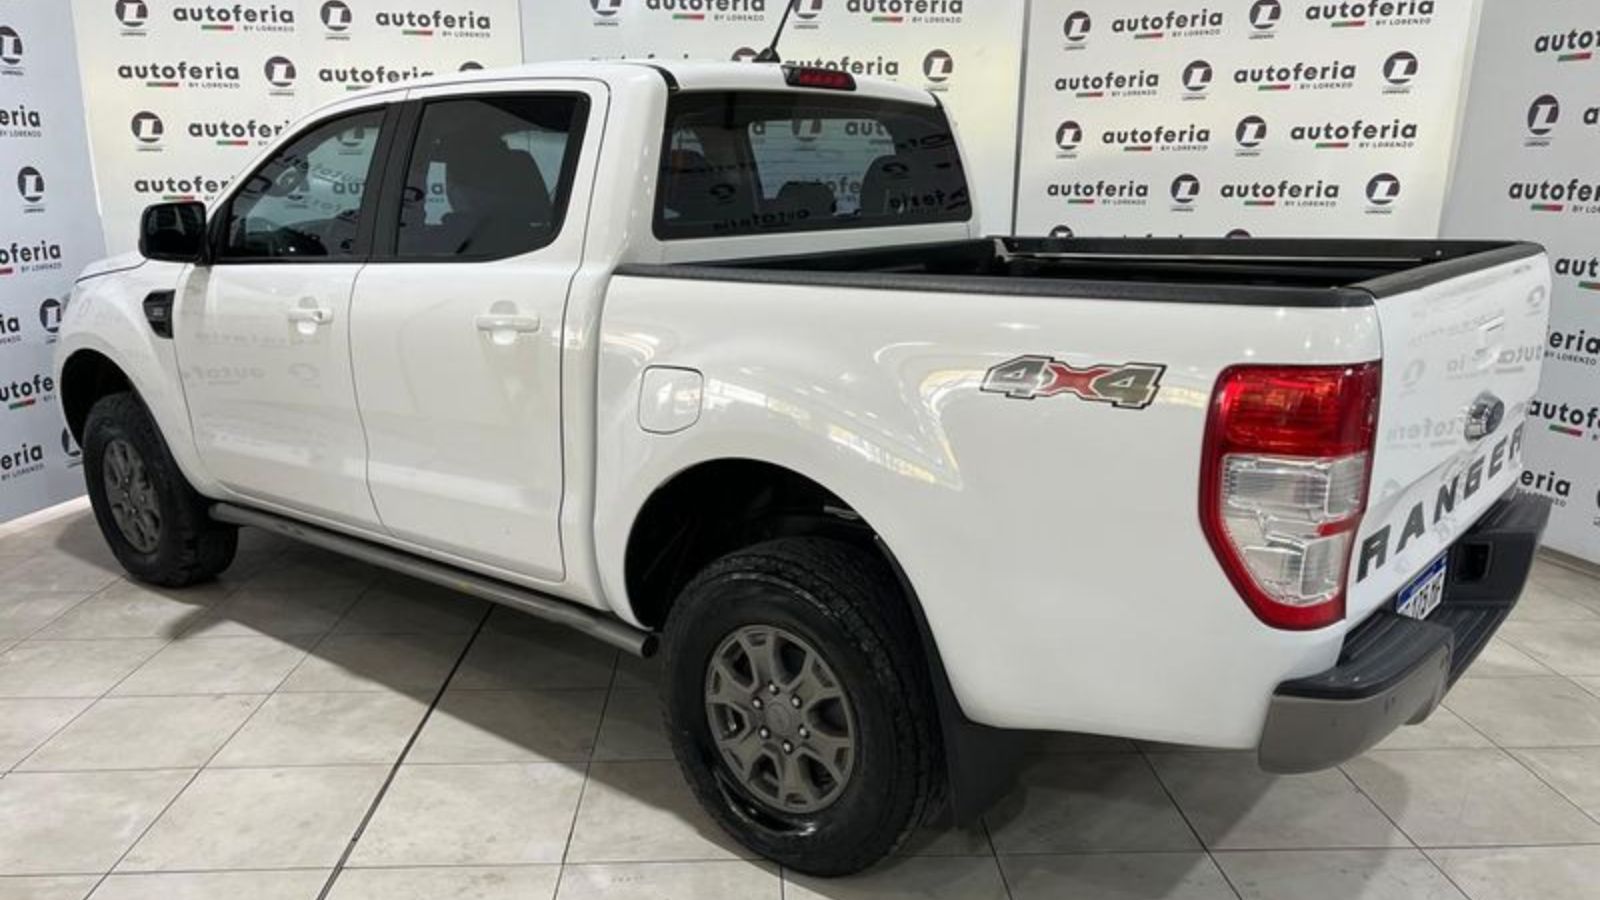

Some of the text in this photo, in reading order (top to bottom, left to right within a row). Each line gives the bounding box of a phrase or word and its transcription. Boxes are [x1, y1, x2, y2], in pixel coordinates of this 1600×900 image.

[174, 5, 294, 23] autoferia
[1305, 0, 1434, 19] autoferia
[376, 11, 490, 28] autoferia
[1111, 9, 1223, 32] autoferia
[118, 62, 239, 79] autoferia
[1055, 70, 1159, 90] autoferia
[1233, 61, 1357, 83] autoferia
[188, 120, 289, 137] autofer
[1102, 124, 1210, 144] autoferia
[1290, 119, 1418, 140] autoferia
[134, 176, 235, 192] autofer
[1047, 181, 1149, 197] autoferia
[1220, 180, 1340, 198] autoferia
[1549, 329, 1600, 354] eria
[1529, 400, 1600, 429] autof
[1356, 421, 1524, 583] RANGER
